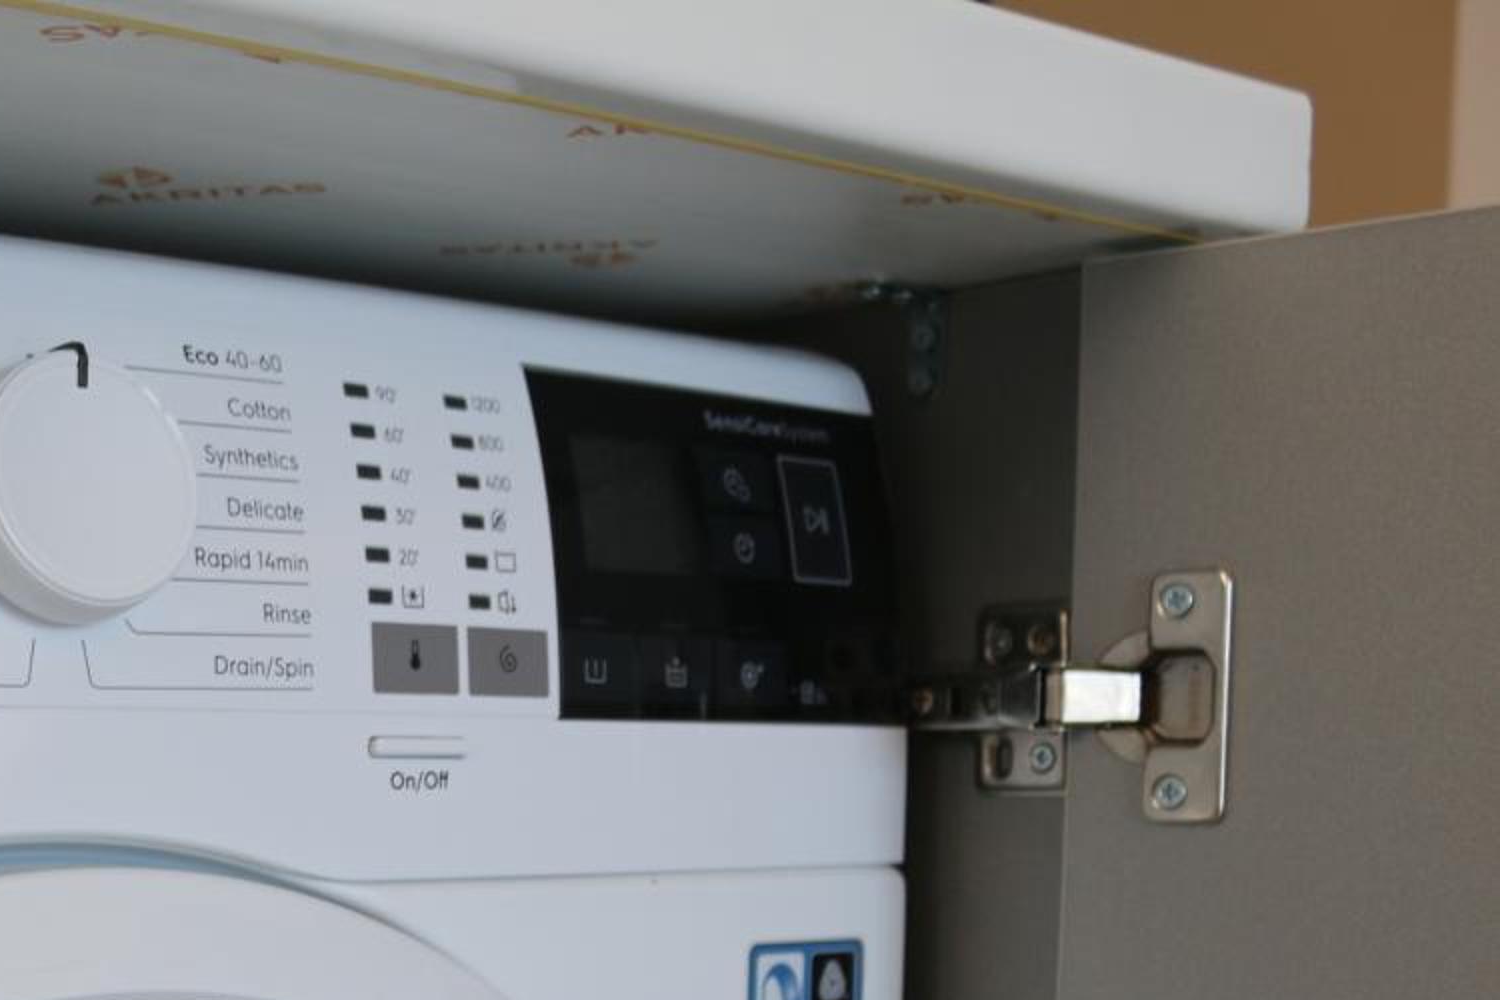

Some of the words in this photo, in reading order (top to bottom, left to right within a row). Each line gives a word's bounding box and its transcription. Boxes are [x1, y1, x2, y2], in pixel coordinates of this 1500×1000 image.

[182, 343, 220, 367] Eco
[224, 350, 284, 374] 40-60
[226, 397, 292, 421] Cotton
[203, 444, 299, 471] Synthetics
[226, 496, 305, 522] Delicate
[195, 547, 252, 572] Rapid
[256, 551, 310, 573] 14min
[262, 602, 313, 626] Rinse
[212, 654, 315, 681] Drain/Spin
[389, 770, 449, 793] On/Off
